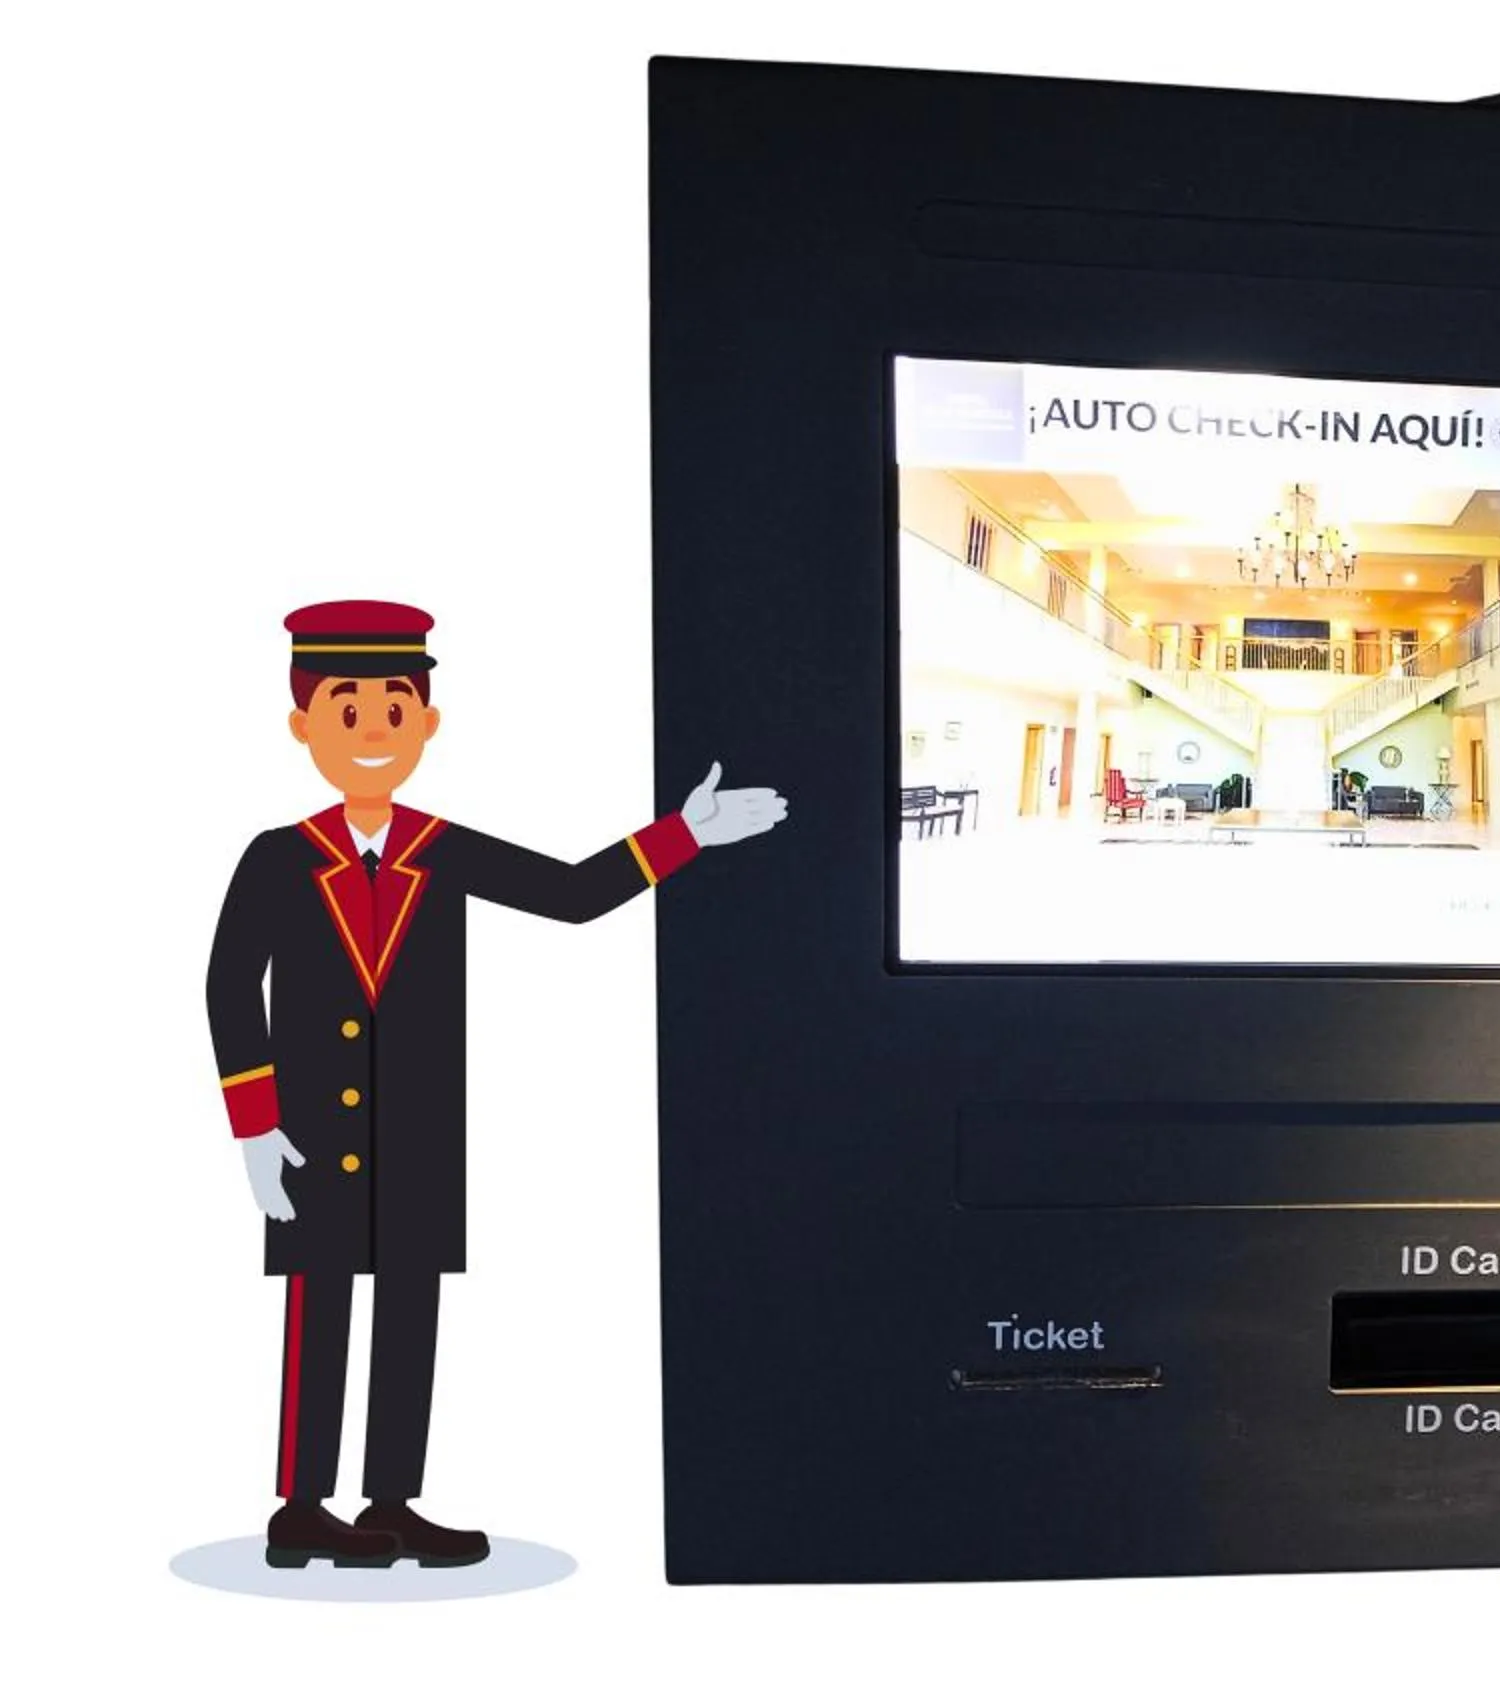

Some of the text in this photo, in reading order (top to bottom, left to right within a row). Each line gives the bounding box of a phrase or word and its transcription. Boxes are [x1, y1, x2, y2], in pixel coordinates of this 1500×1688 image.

[1029, 397, 1158, 435] ¡AUTO
[1167, 401, 1361, 444] CHECK-IN
[1369, 409, 1484, 452] AQUÍ!
[1401, 1245, 1439, 1275] ID
[987, 1315, 1105, 1350] Ticket
[1405, 1404, 1442, 1433] ID
